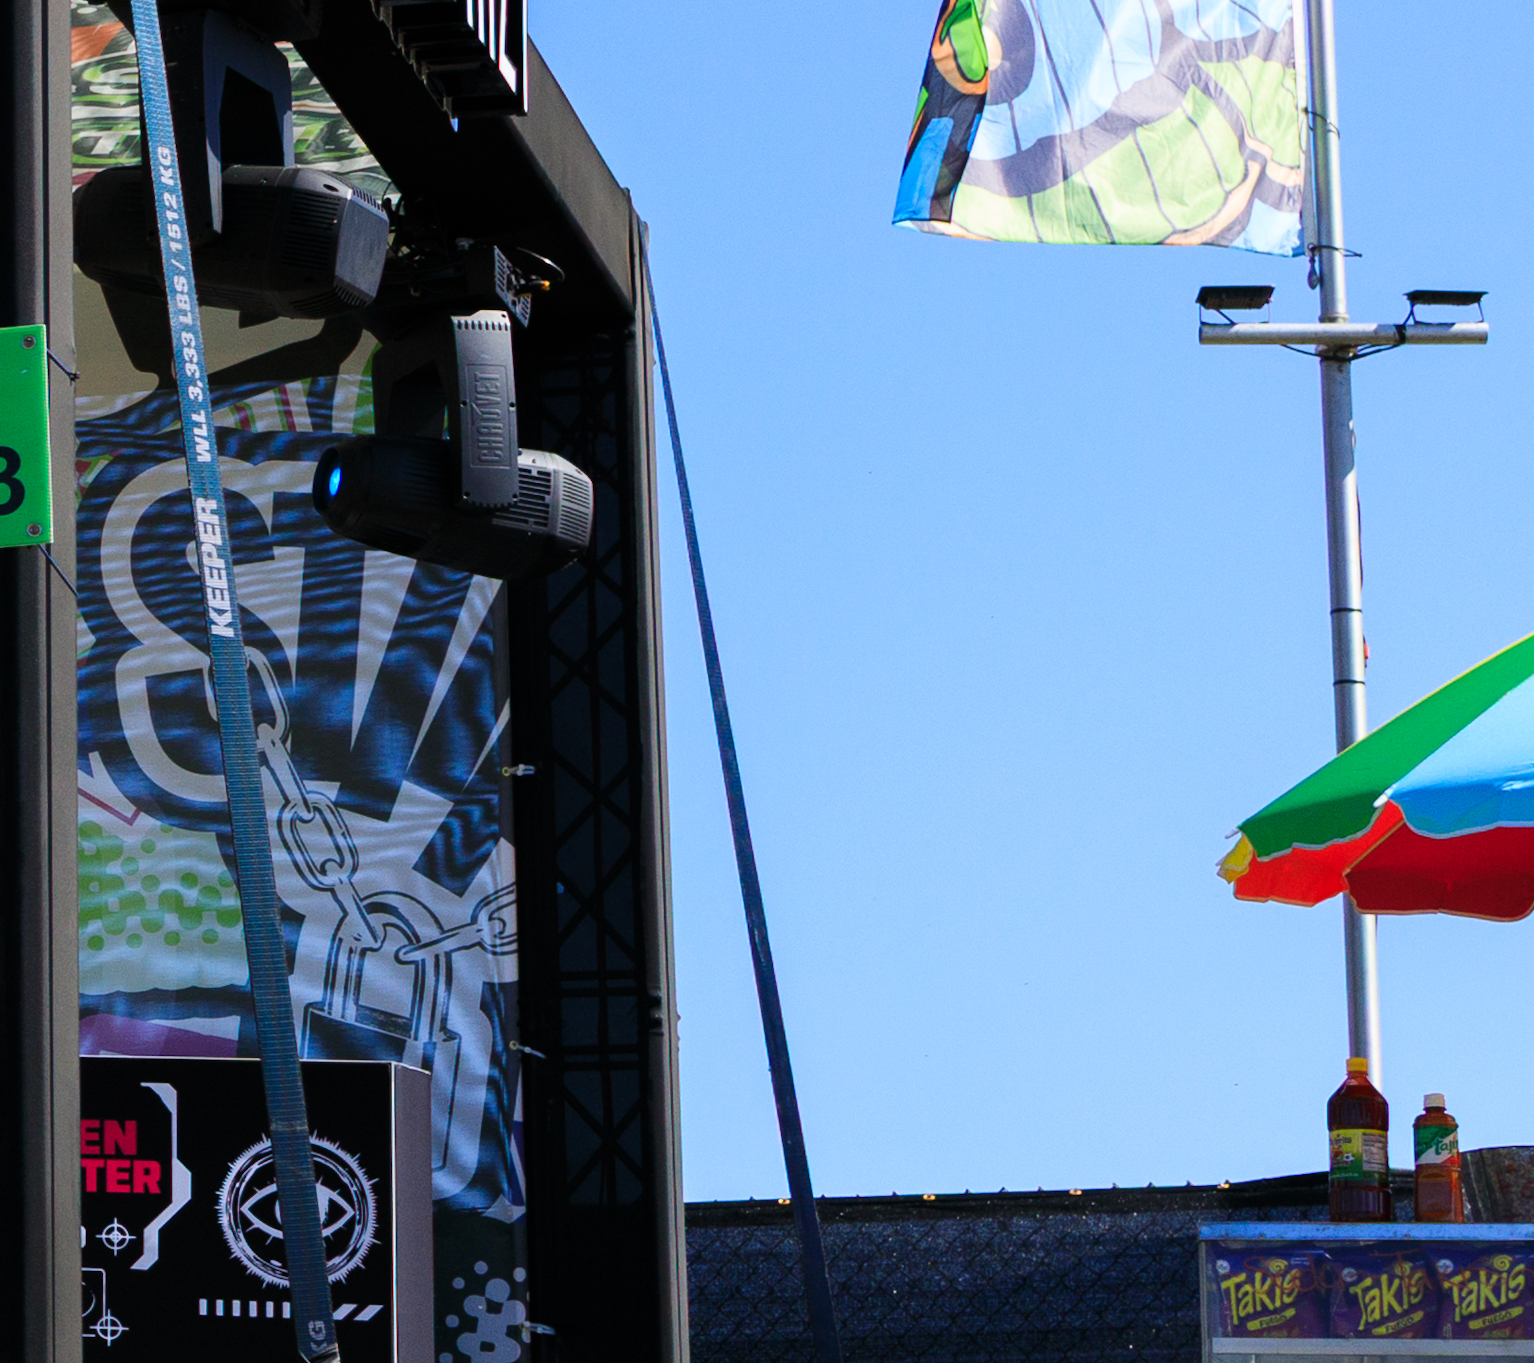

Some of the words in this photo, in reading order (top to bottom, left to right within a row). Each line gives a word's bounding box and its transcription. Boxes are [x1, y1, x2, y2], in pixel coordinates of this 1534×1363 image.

[156, 145, 177, 186] KG
[161, 190, 184, 253] 1512
[173, 277, 194, 327] LBS
[187, 408, 213, 464] WLL
[196, 497, 235, 638] KEEPER
[1221, 1267, 1302, 1326] Takis
[1350, 1269, 1426, 1331] Takis
[1442, 1263, 1526, 1324] Takis
